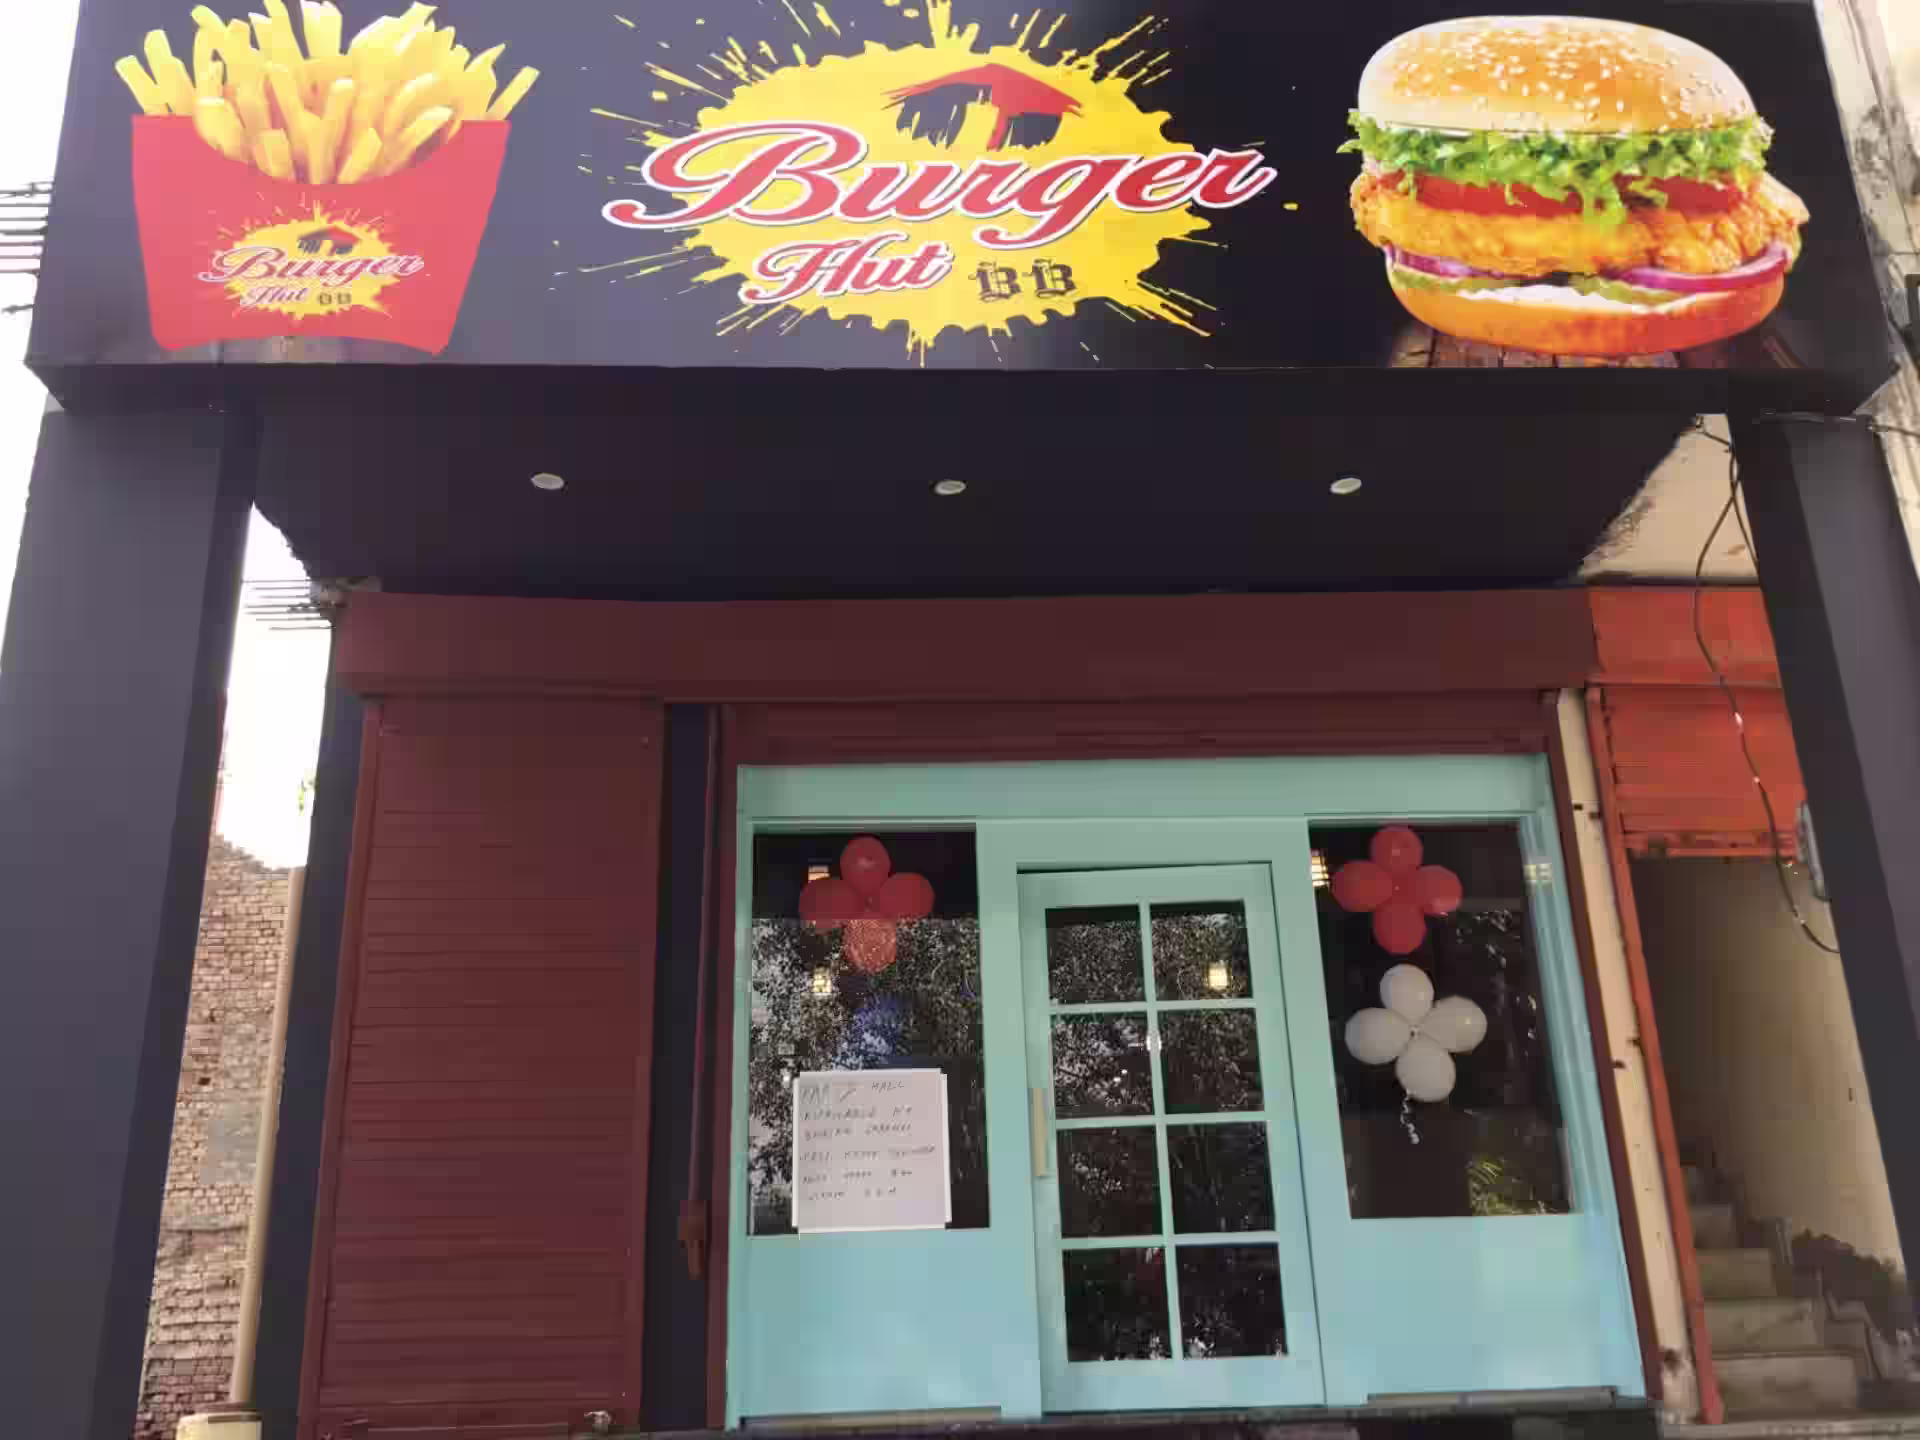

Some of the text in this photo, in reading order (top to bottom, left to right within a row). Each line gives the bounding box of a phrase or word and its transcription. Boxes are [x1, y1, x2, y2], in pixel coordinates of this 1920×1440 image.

[603, 122, 1278, 248] Burger
[196, 245, 425, 287] Burger
[738, 232, 954, 304] Hut
[241, 287, 310, 306] Hut
